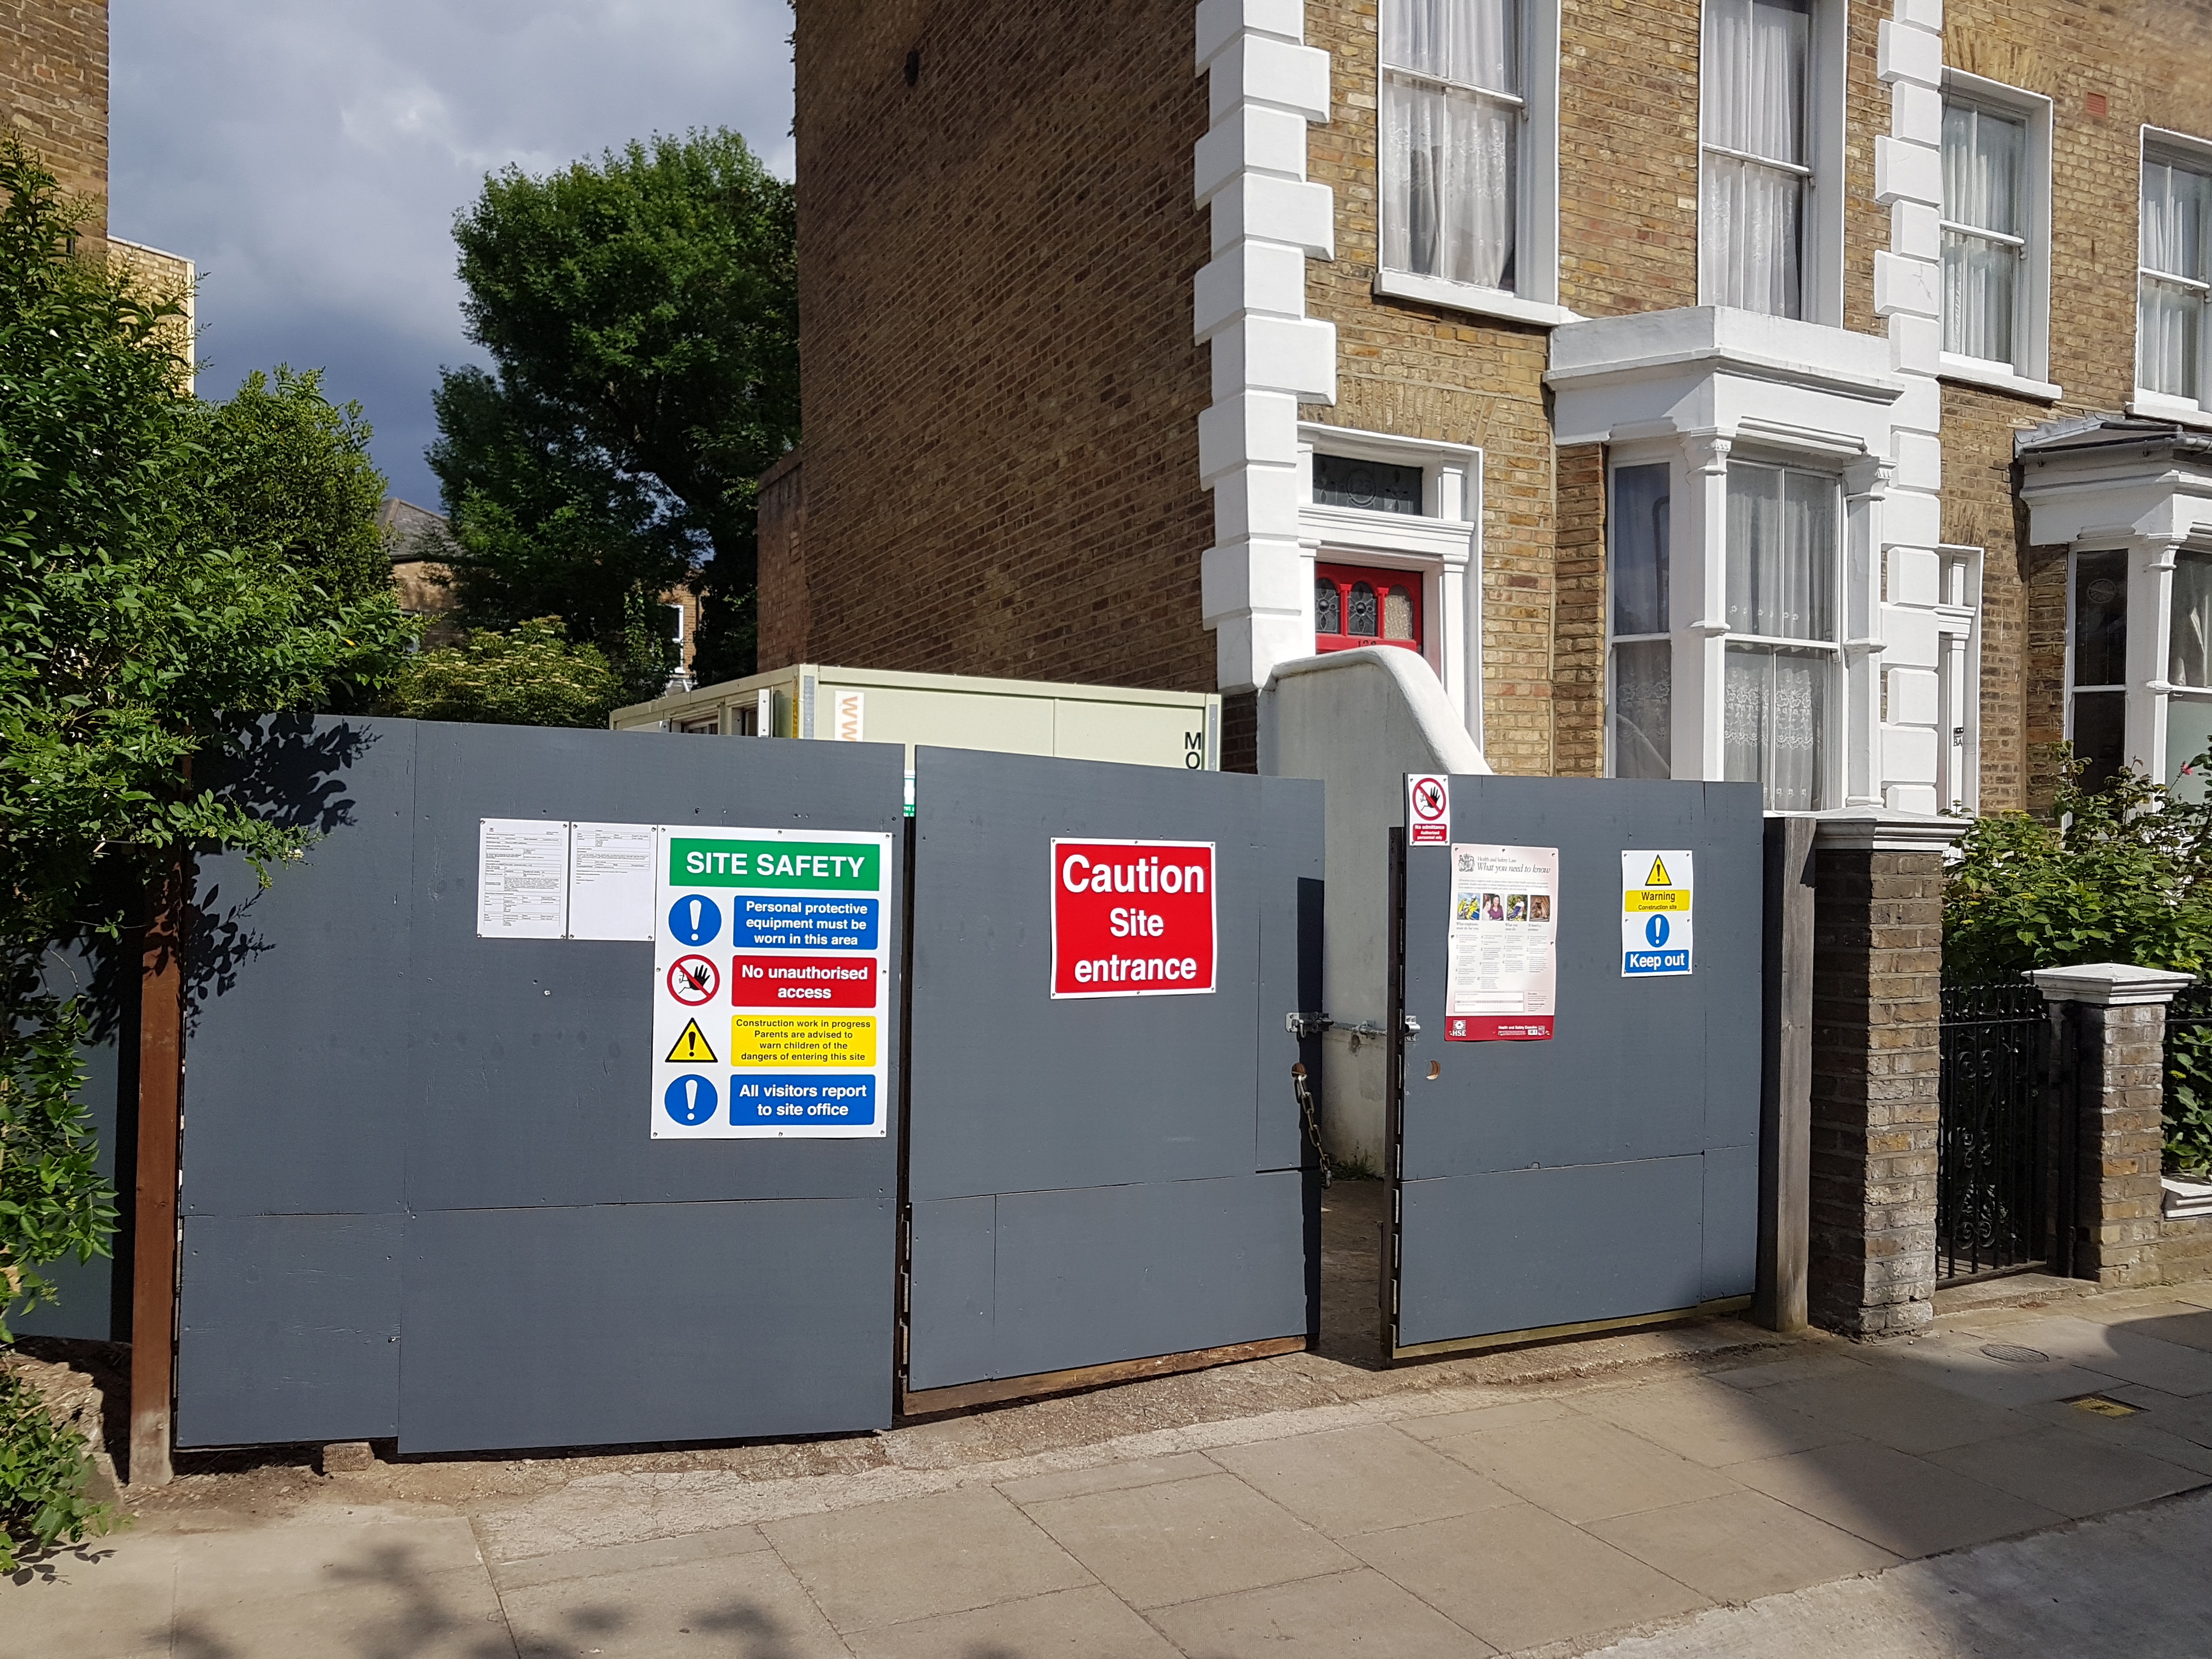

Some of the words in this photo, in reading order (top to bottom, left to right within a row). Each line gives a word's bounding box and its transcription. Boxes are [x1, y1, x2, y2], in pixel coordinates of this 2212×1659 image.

[687, 851, 747, 874] SITE
[757, 854, 865, 877] SAFETY
[1477, 862, 1494, 871] What
[1495, 865, 1507, 873] you
[1509, 864, 1523, 872] need
[1532, 865, 1551, 873] know
[1063, 854, 1205, 894] Caution
[1641, 891, 1675, 902] Warning
[747, 901, 801, 912] Personal
[805, 904, 867, 915] protective
[747, 918, 812, 930] equipment
[817, 919, 848, 929] must
[851, 919, 866, 929] be
[1110, 907, 1164, 937] Site
[790, 934, 800, 944] in
[805, 934, 827, 944] this
[1630, 953, 1661, 970] Keep
[1664, 952, 1685, 967] out
[742, 965, 763, 978] No
[769, 966, 867, 979] unauthorised
[1074, 955, 1197, 983] entrance
[778, 988, 831, 998] access
[741, 1053, 777, 1062] dangers
[792, 1053, 827, 1062] entering
[740, 1085, 758, 1096] All
[764, 1085, 817, 1097] visitors
[822, 1085, 866, 1099] report
[758, 1104, 771, 1115] to
[777, 1103, 803, 1115] site
[808, 1103, 848, 1115] office
